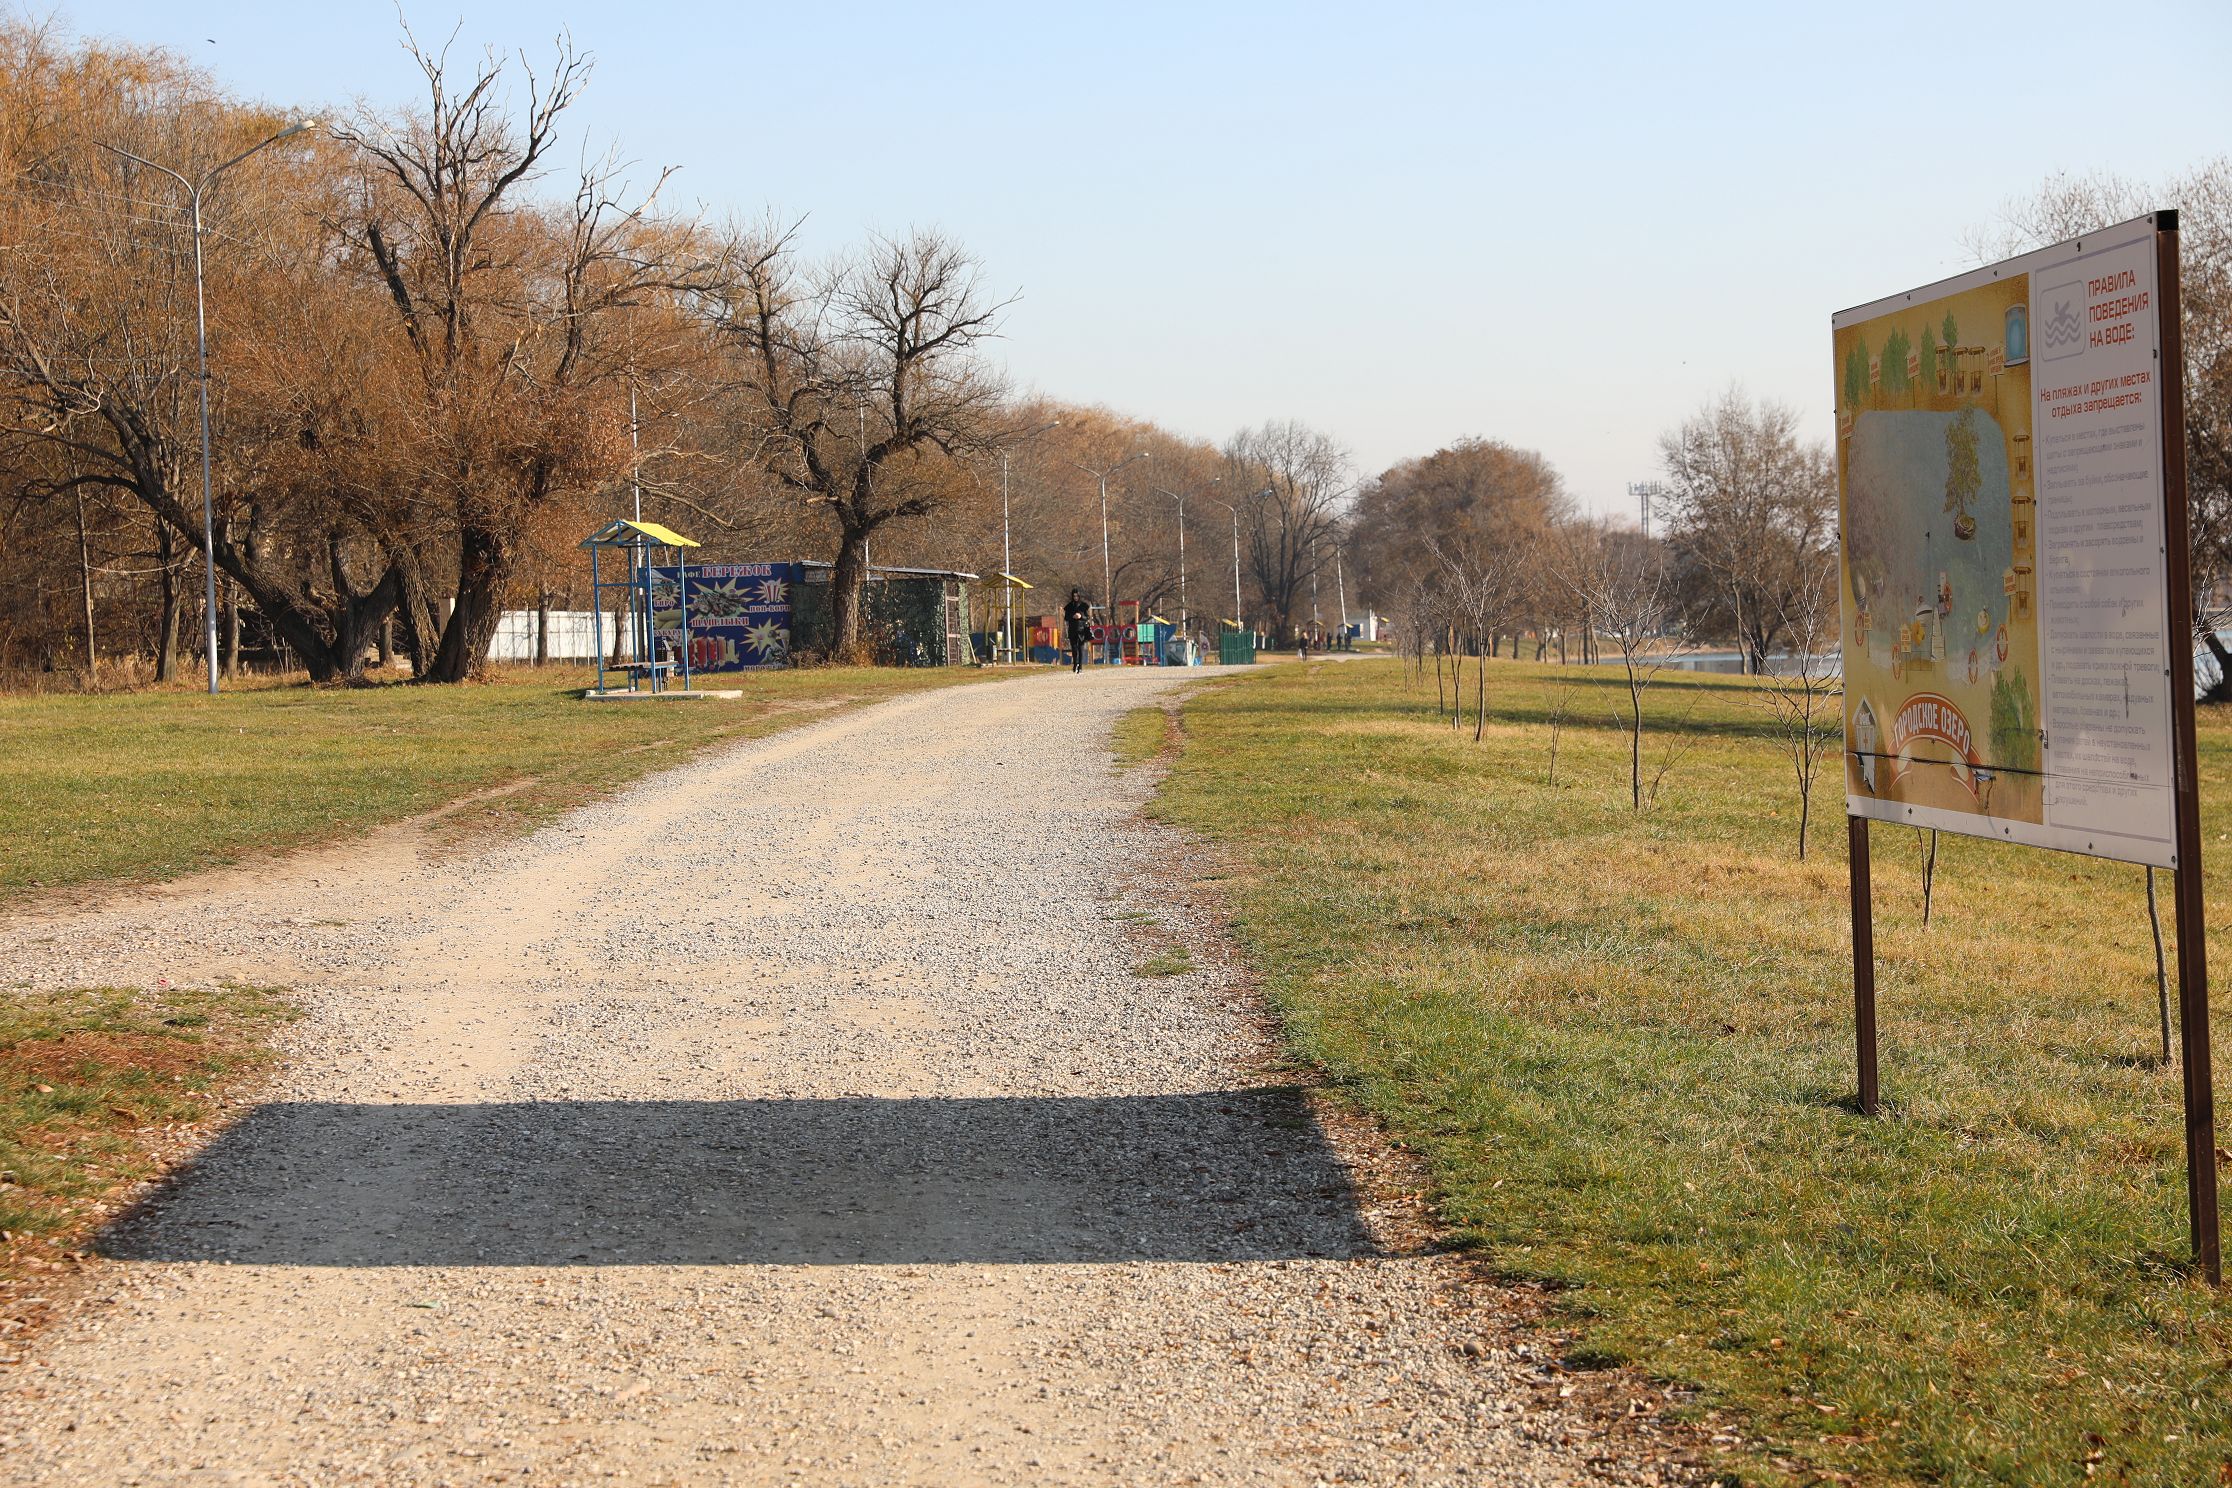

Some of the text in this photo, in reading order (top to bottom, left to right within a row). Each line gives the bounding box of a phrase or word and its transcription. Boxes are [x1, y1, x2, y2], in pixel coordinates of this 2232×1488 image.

[2088, 269, 2136, 298] ПРАВИЛА
[2089, 292, 2149, 323] ПОВЕДЕНИЯ
[2089, 323, 2135, 348] НА ВОДЕ:
[2040, 370, 2151, 402] На пляжах и других местах
[2051, 392, 2142, 419] отдыха запрещается:
[702, 565, 772, 578] БЕРЕЖОК
[691, 617, 750, 627] ШАШЛЫКИ
[749, 604, 791, 613] ПОП-КОРН
[1894, 703, 1970, 755] ГОРОДСКОЕ ОЗЕРО
